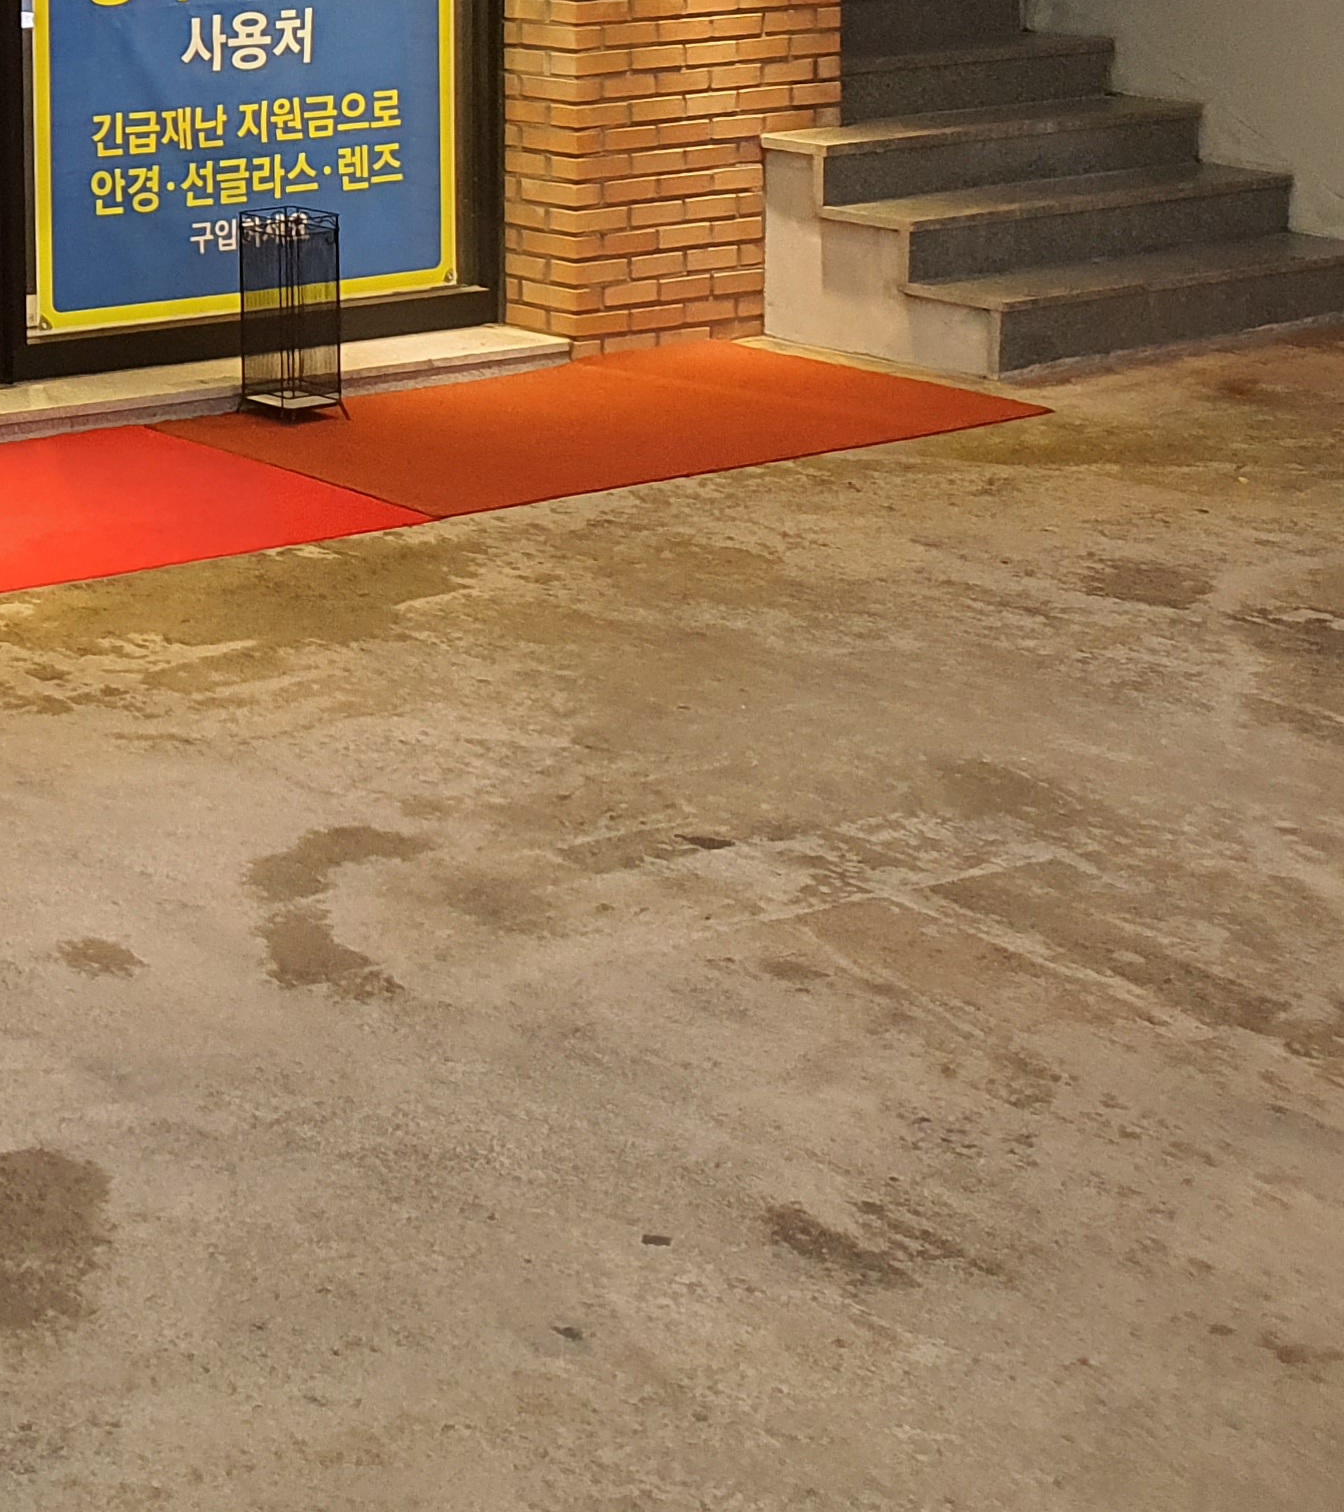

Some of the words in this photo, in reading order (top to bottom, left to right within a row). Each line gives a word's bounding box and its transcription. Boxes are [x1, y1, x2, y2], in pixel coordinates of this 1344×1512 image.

[180, 6, 315, 73] 사용처
[91, 104, 229, 158] 긴급재난
[236, 88, 403, 143] 지원금으로
